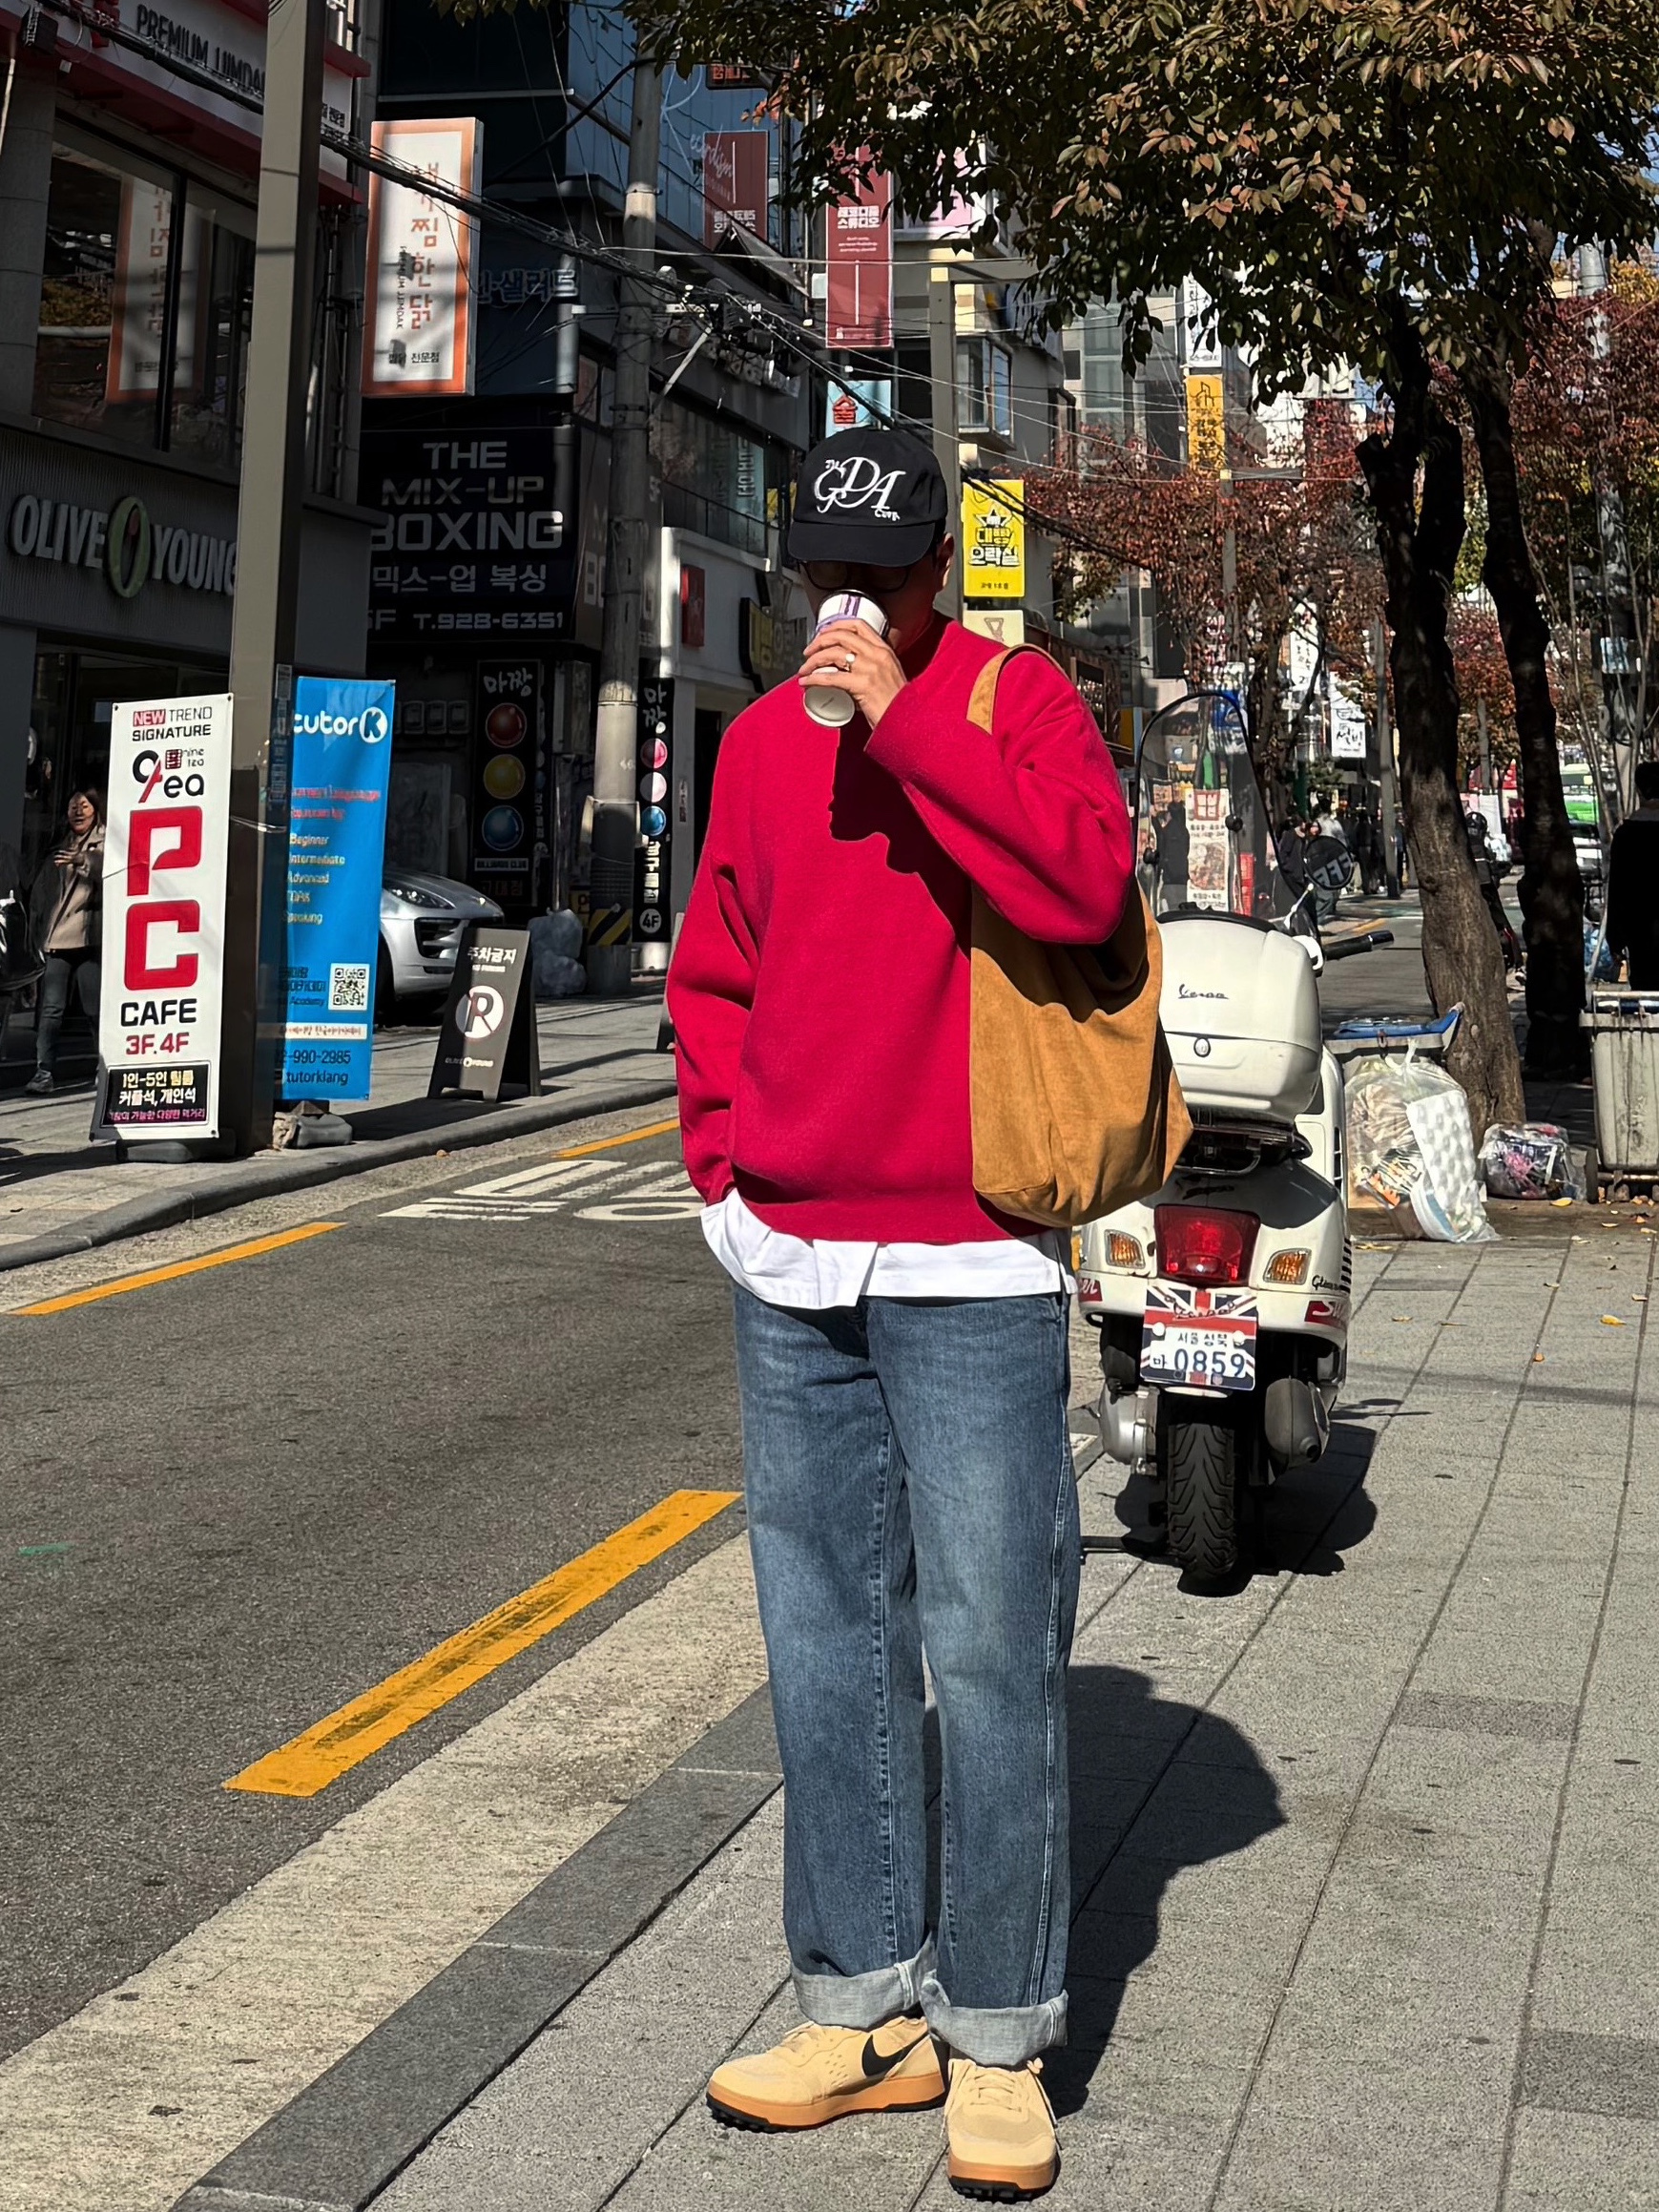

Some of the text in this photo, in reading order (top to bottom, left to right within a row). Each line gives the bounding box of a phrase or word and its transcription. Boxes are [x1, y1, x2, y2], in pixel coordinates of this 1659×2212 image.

[423, 441, 508, 470] THE
[382, 476, 545, 506] MIX-UP
[9, 494, 109, 570] OLIVE
[968, 545, 1022, 567] 오락실
[373, 564, 548, 594] 믹스-업 복싱
[412, 612, 564, 631] T.928-6351
[483, 667, 533, 698] 마짱
[134, 706, 213, 726] NEW TREND
[132, 724, 212, 741] SIGNATURE
[290, 833, 330, 847] Beginner
[289, 852, 346, 865] Intermediate
[641, 913, 660, 929] 4F
[467, 946, 517, 965] 주차금지
[120, 998, 197, 1028] CAFE
[126, 1032, 190, 1055] 3F.4F
[122, 1071, 168, 1089] 1인-5인
[286, 1070, 349, 1086] tutorklang
[1177, 1332, 1228, 1347] 서울 성북
[1152, 1347, 1246, 1377] 마 0859
